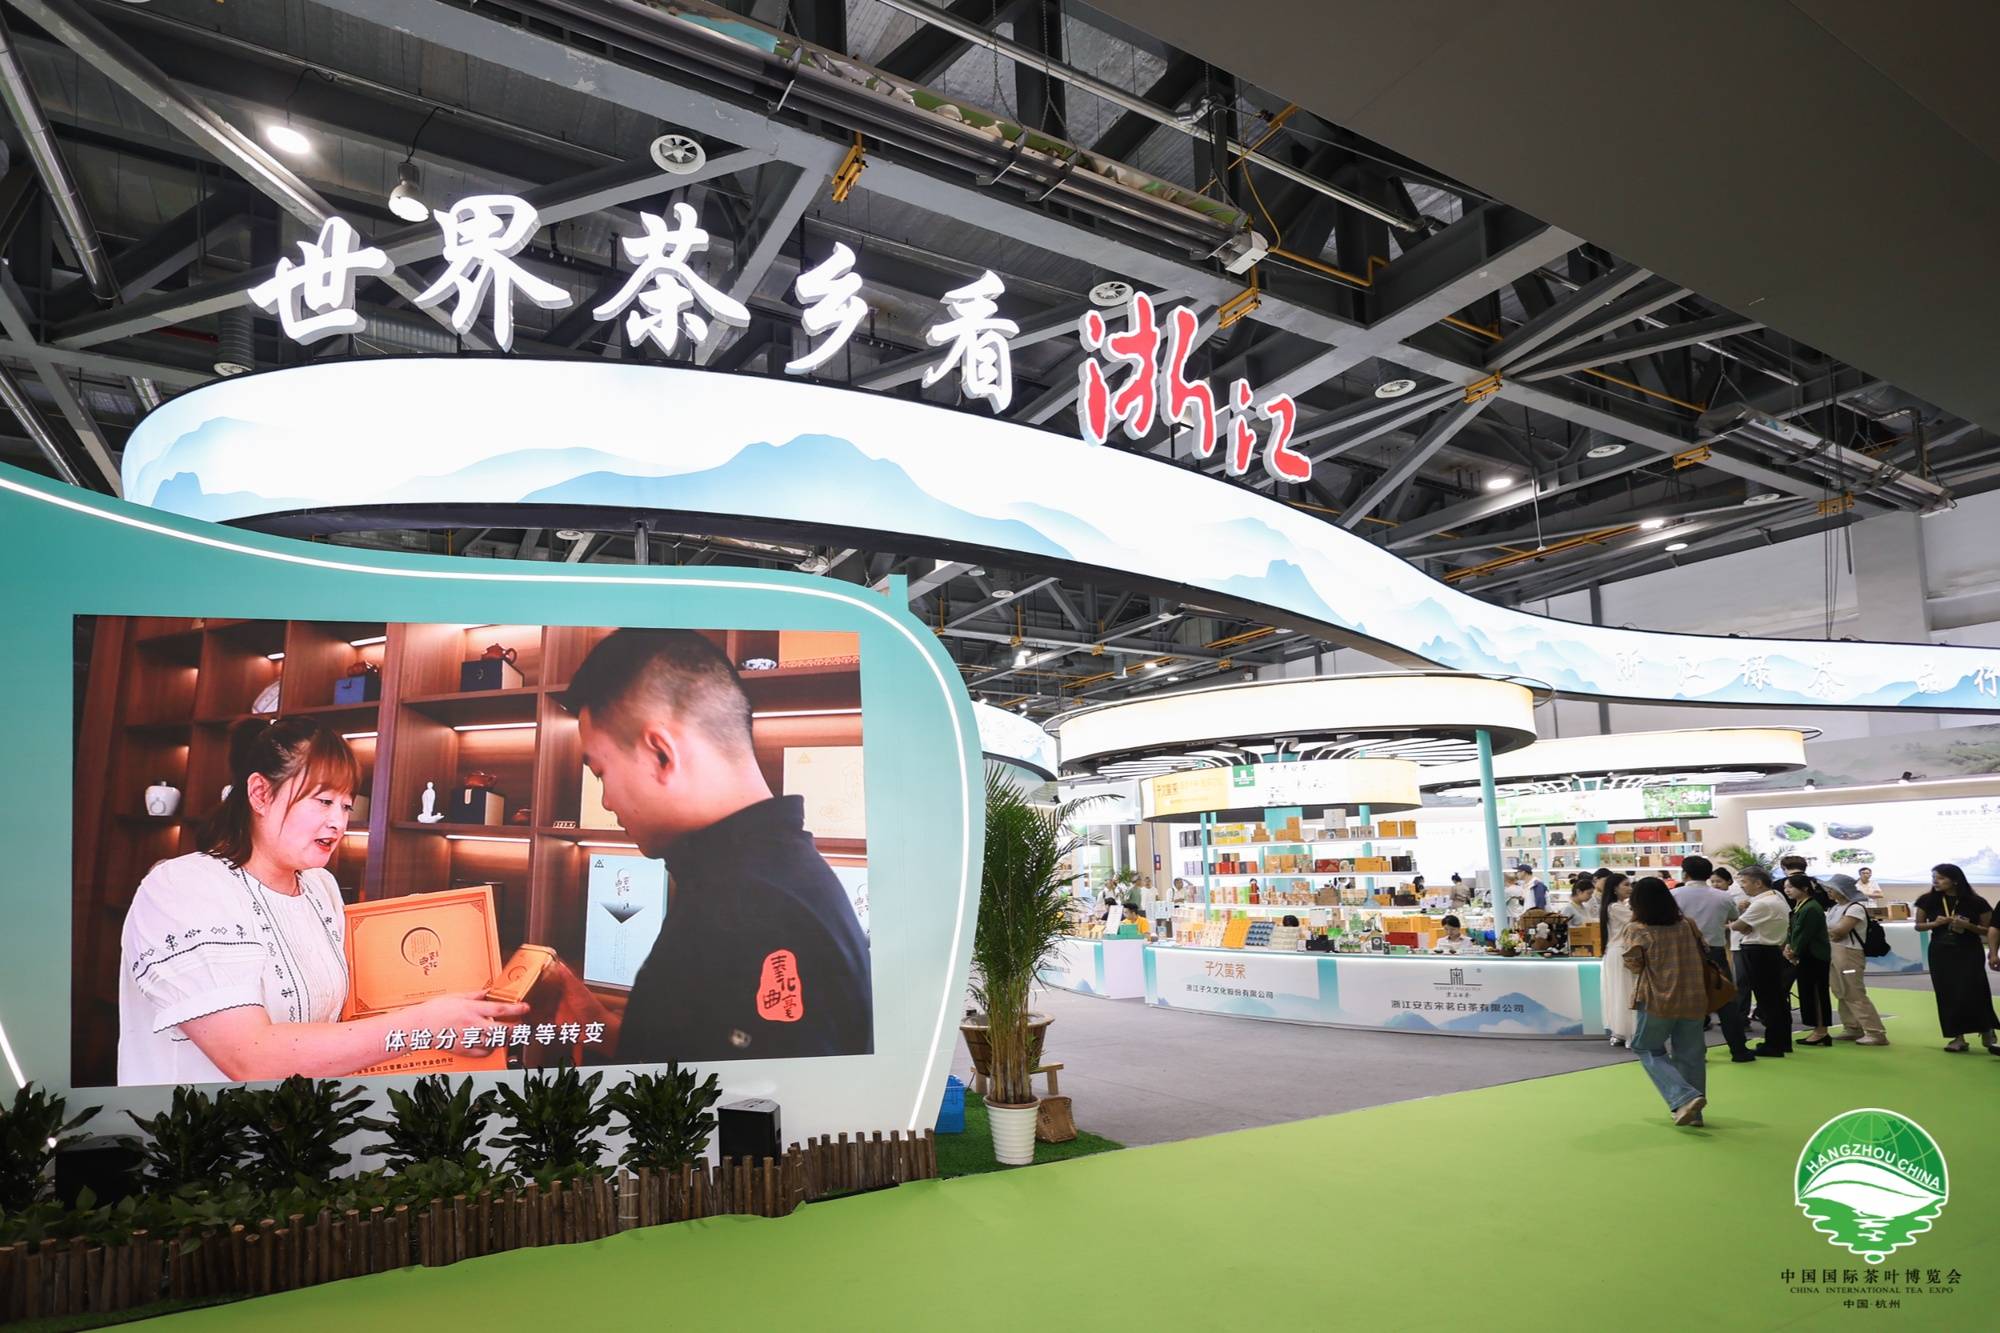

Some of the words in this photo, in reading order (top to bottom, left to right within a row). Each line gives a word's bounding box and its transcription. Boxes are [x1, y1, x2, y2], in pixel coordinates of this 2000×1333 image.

[247, 194, 1312, 484] 世界茶乡看浙江
[384, 1021, 606, 1052] 体验分享消费等转变
